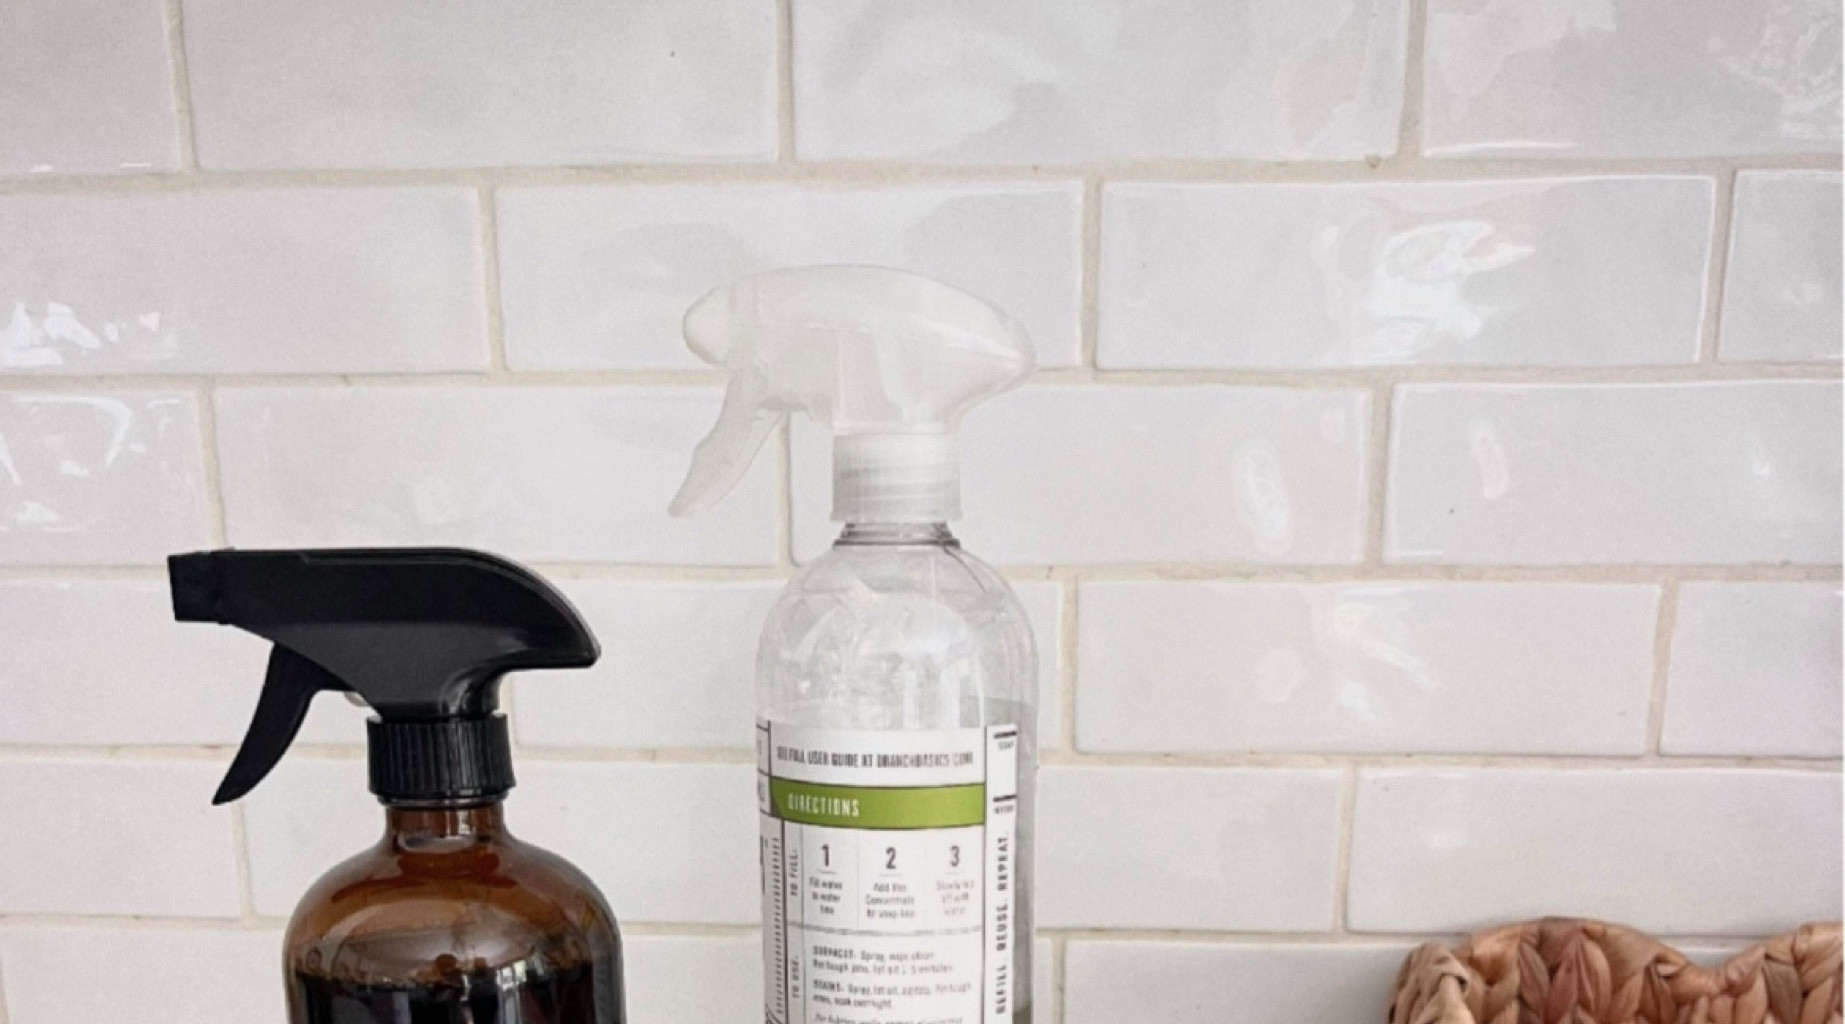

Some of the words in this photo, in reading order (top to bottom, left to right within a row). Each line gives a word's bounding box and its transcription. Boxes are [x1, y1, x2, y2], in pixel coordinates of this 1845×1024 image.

[831, 753, 858, 768] GUIDE
[862, 753, 873, 768] AT
[877, 751, 973, 768] BRANCHBASICSCOM
[788, 793, 859, 818] DIRECTIONS
[822, 843, 830, 867] 1
[886, 846, 897, 869] 2
[949, 844, 960, 867] 3
